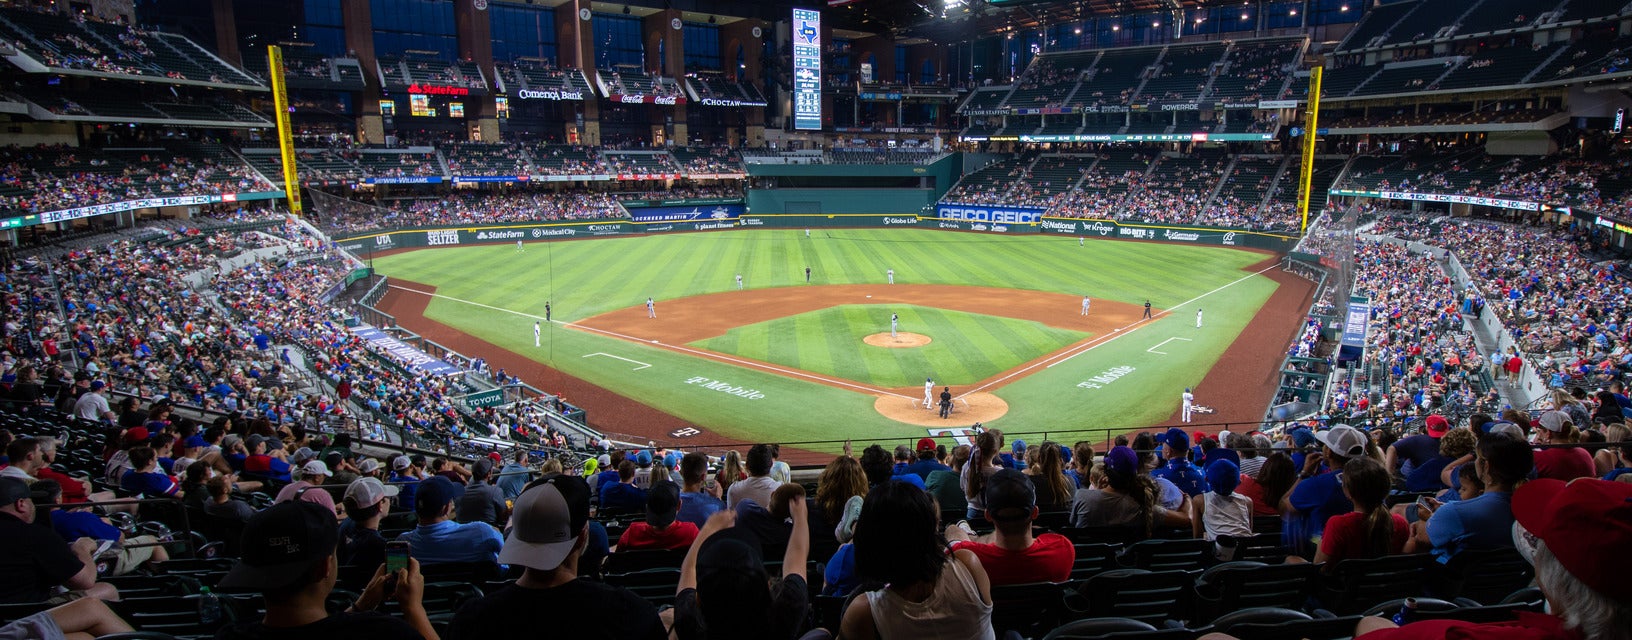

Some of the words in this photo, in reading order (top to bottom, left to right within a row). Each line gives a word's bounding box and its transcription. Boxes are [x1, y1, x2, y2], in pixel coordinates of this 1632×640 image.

[561, 91, 583, 100] Bank
[621, 94, 644, 104] Coca-Cola
[654, 96, 677, 105] Coca-Cola
[707, 99, 741, 107] CHOCTAW
[1161, 103, 1199, 111] POWERADE
[939, 207, 988, 222] GEICO
[1048, 220, 1076, 230] National
[1092, 221, 1114, 236] Kroger
[564, 228, 576, 236] City
[1131, 228, 1146, 236] BITE
[376, 234, 392, 245] UTA
[428, 234, 460, 246] SELTZER
[468, 394, 501, 406] TOYOTA
